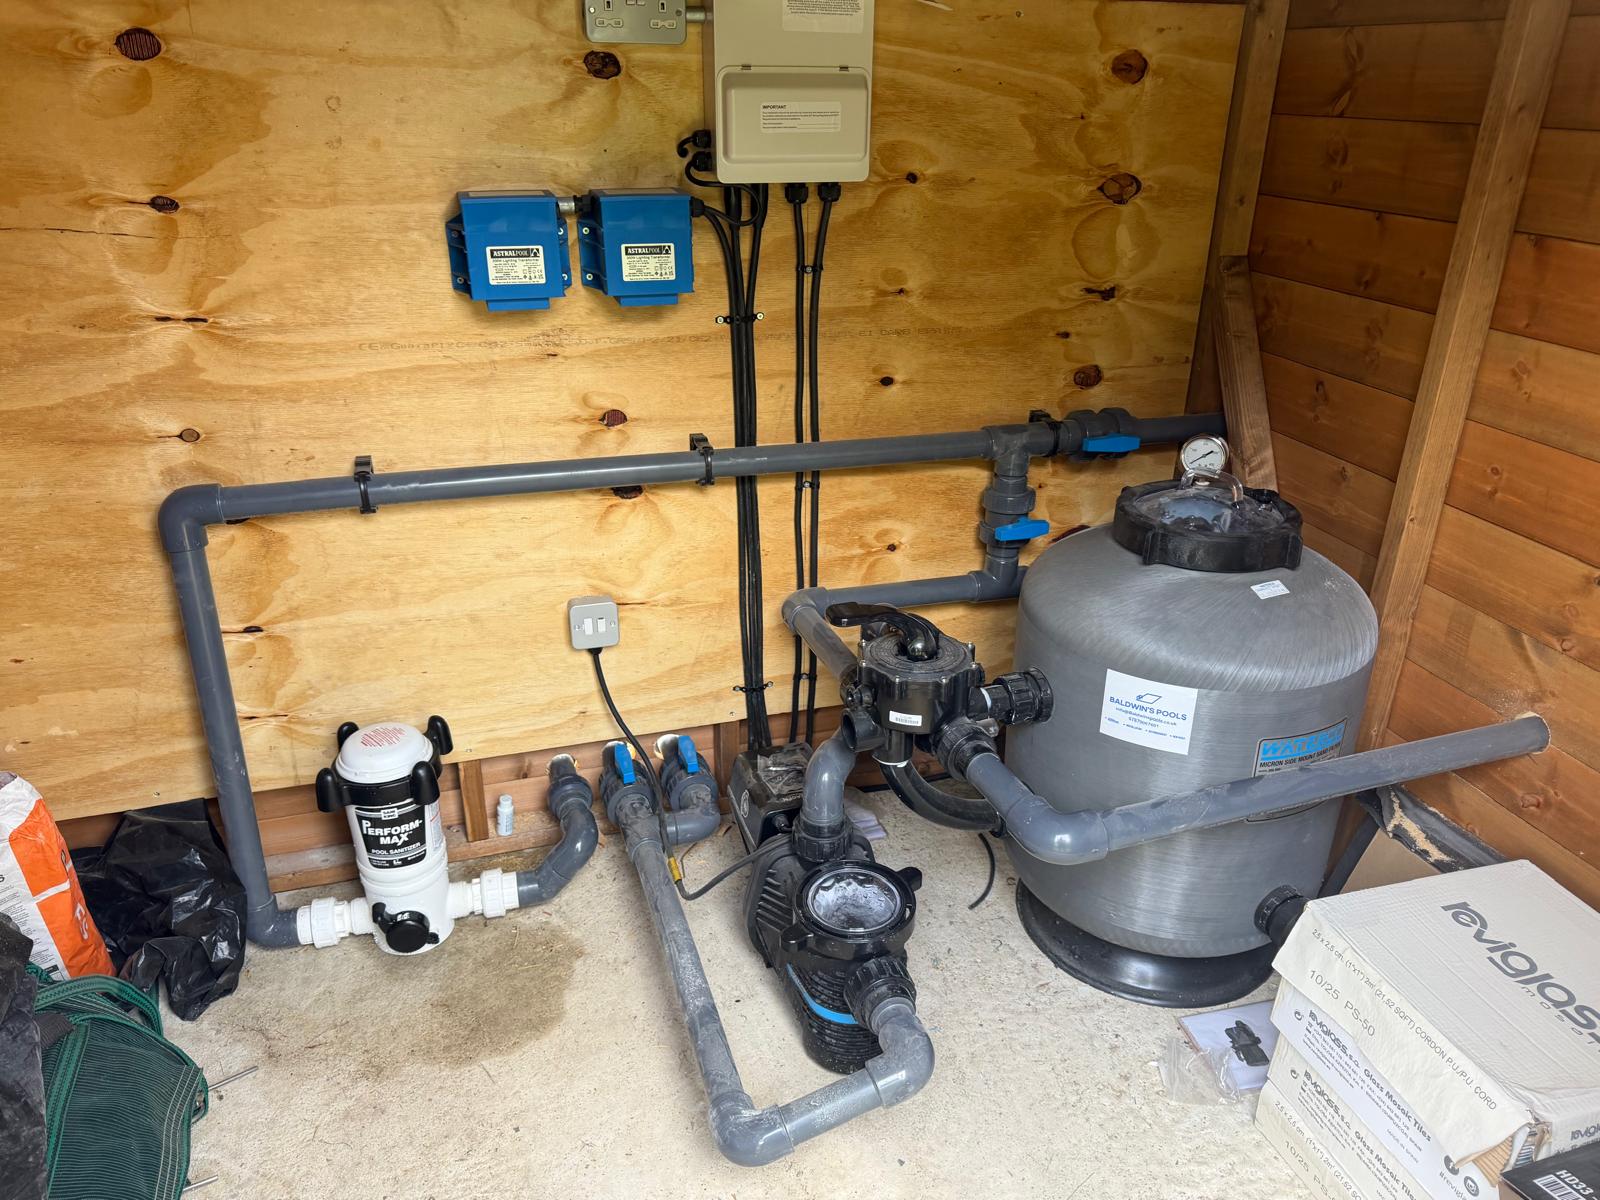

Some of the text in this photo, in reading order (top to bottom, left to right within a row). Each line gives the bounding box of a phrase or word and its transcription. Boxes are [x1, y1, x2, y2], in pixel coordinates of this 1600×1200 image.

[1109, 696, 1188, 721] BALDWIN'S POOLS
[1259, 760, 1284, 768] MICRON
[1284, 758, 1297, 766] SIDE
[389, 842, 421, 855] SANITIZER
[1309, 970, 1376, 1037] 10/25 PS-50
[1393, 1006, 1416, 1030] SQFT)
[1415, 1026, 1447, 1060] CORDON
[1473, 1086, 1498, 1111] CORD
[1363, 1068, 1385, 1093] Glass
[1385, 1091, 1413, 1122] Mosaic
[1413, 1118, 1432, 1142] Tiles
[1285, 1140, 1309, 1173] 10/25
[1353, 1130, 1375, 1156] Glass
[1374, 1153, 1402, 1185] Mosaic
[1556, 1169, 1594, 1196] HD33
